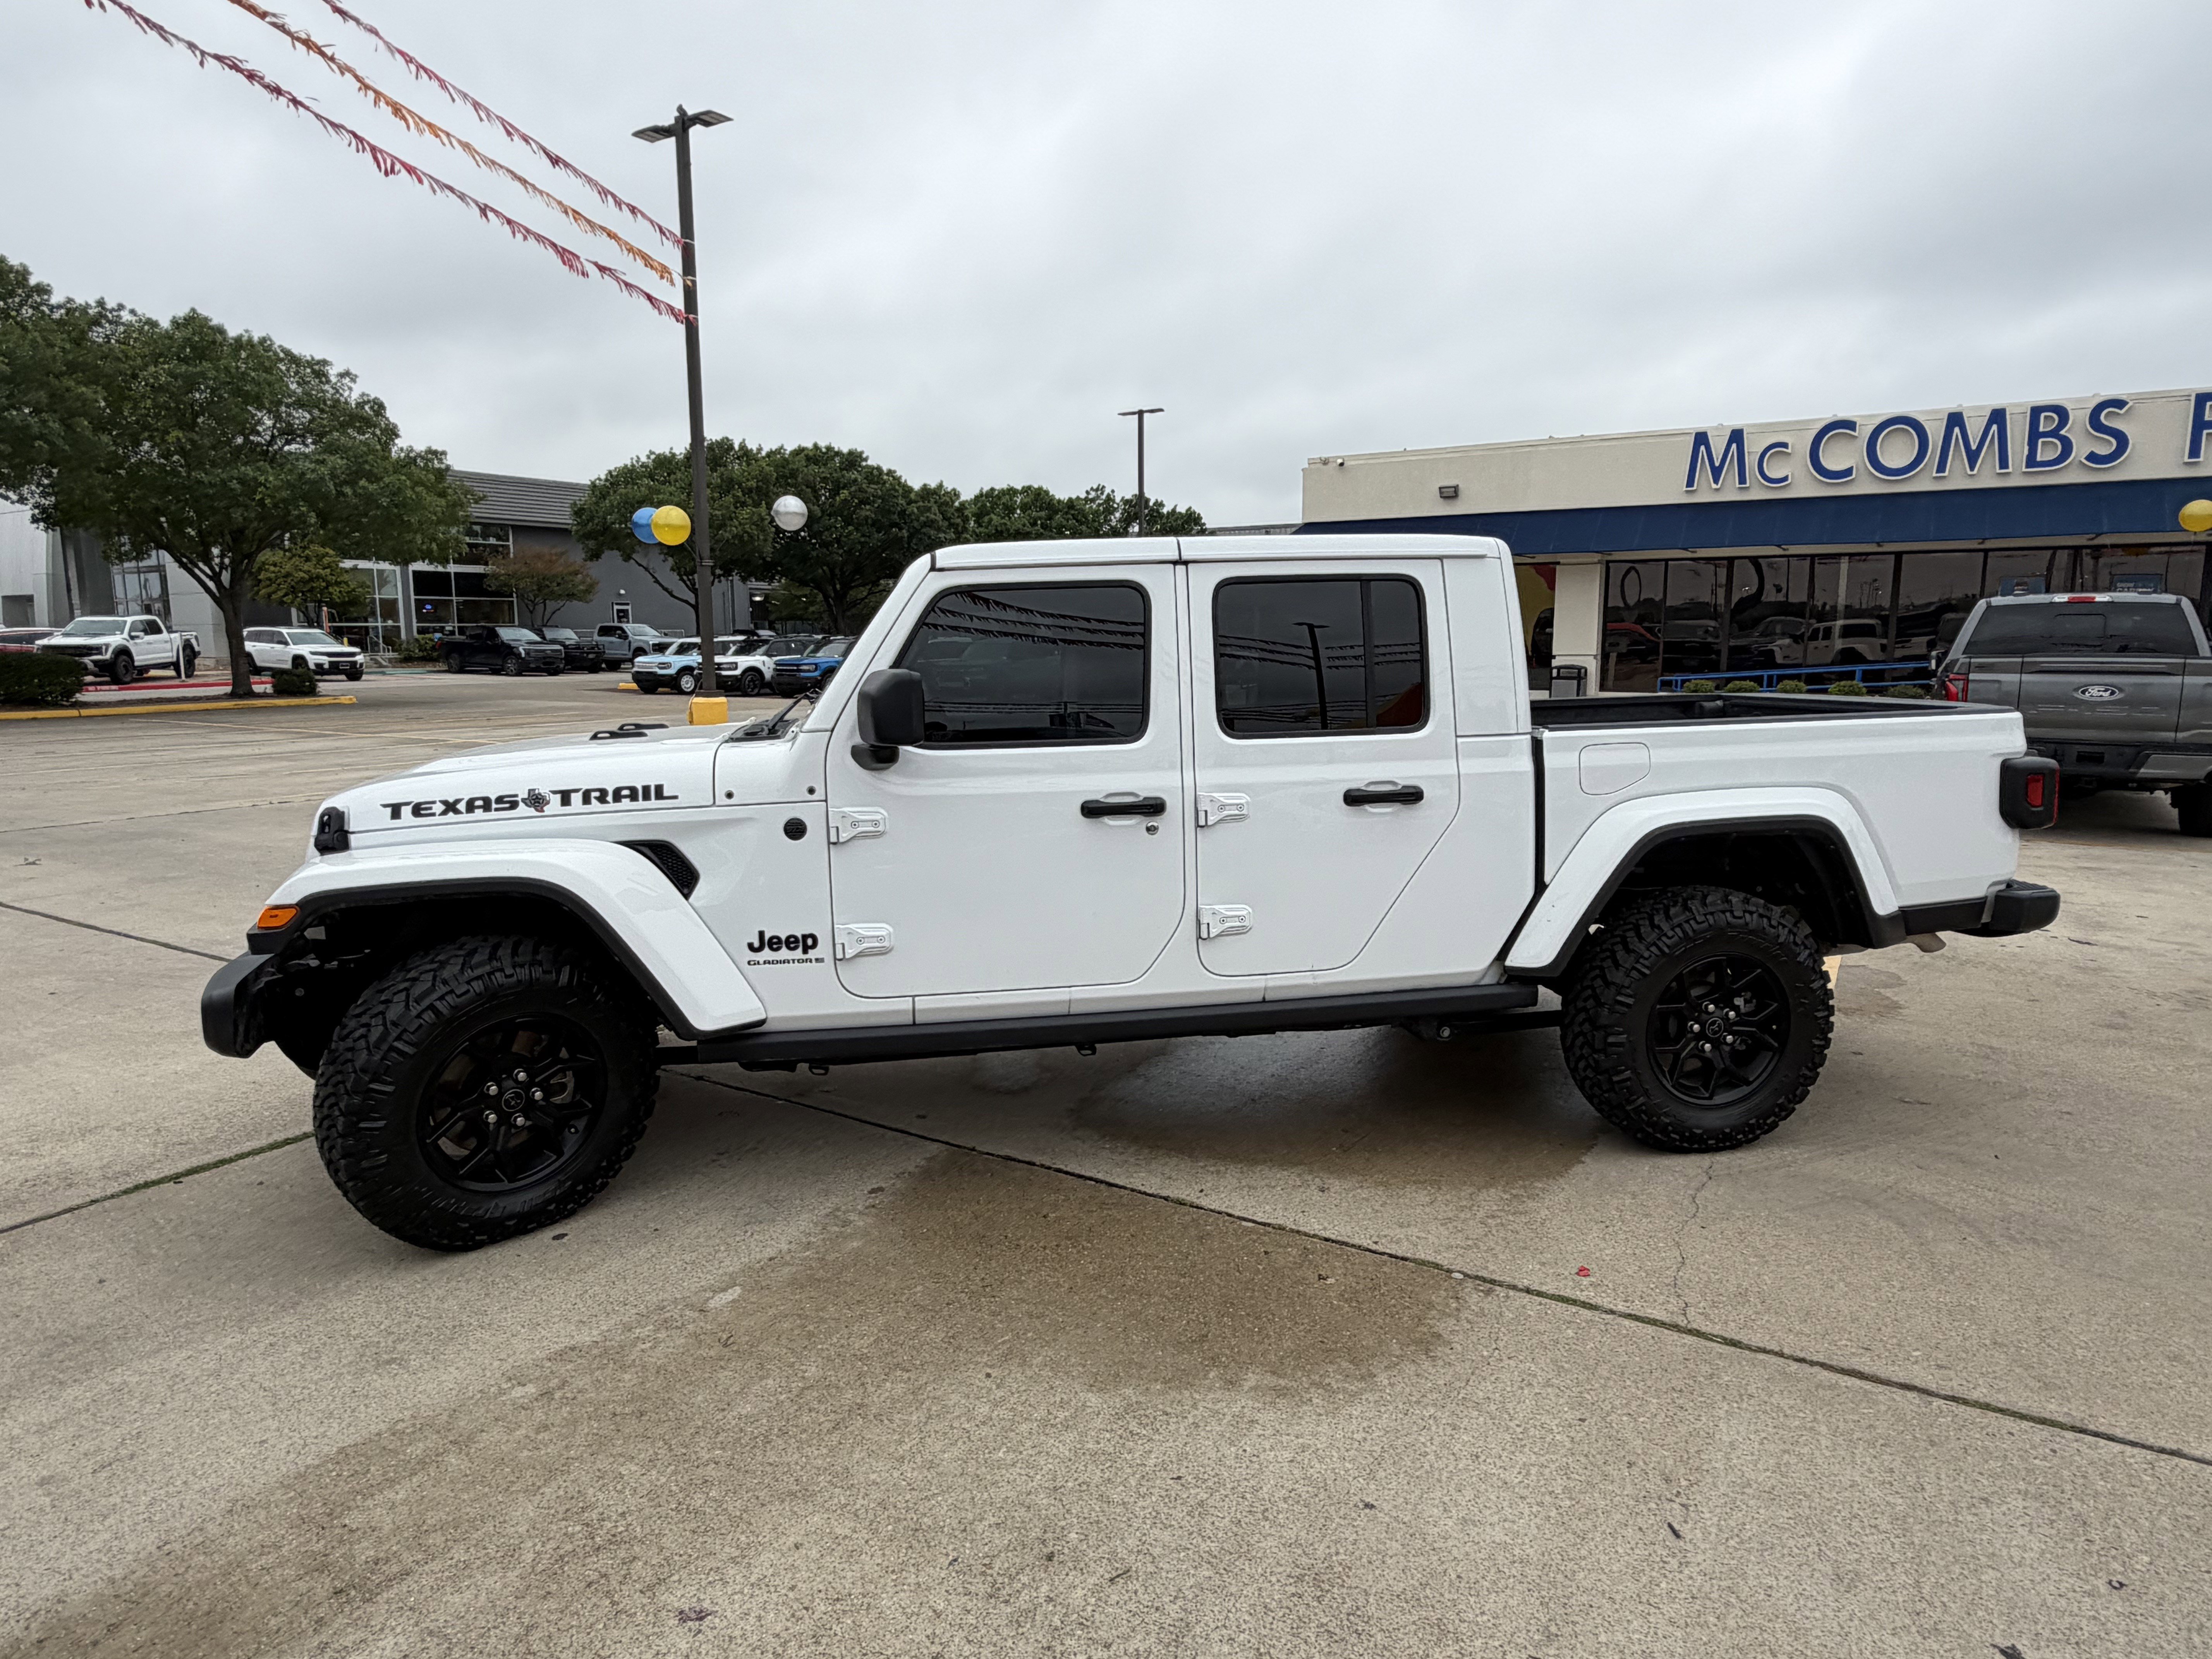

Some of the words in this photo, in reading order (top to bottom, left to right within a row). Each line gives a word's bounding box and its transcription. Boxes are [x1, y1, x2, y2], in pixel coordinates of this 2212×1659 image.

[2085, 687, 2112, 697] Ford
[380, 793, 520, 820] TEXAS
[549, 784, 678, 807] TRAIL
[747, 930, 819, 955] Jeep
[747, 958, 813, 966] GLADIATOR
